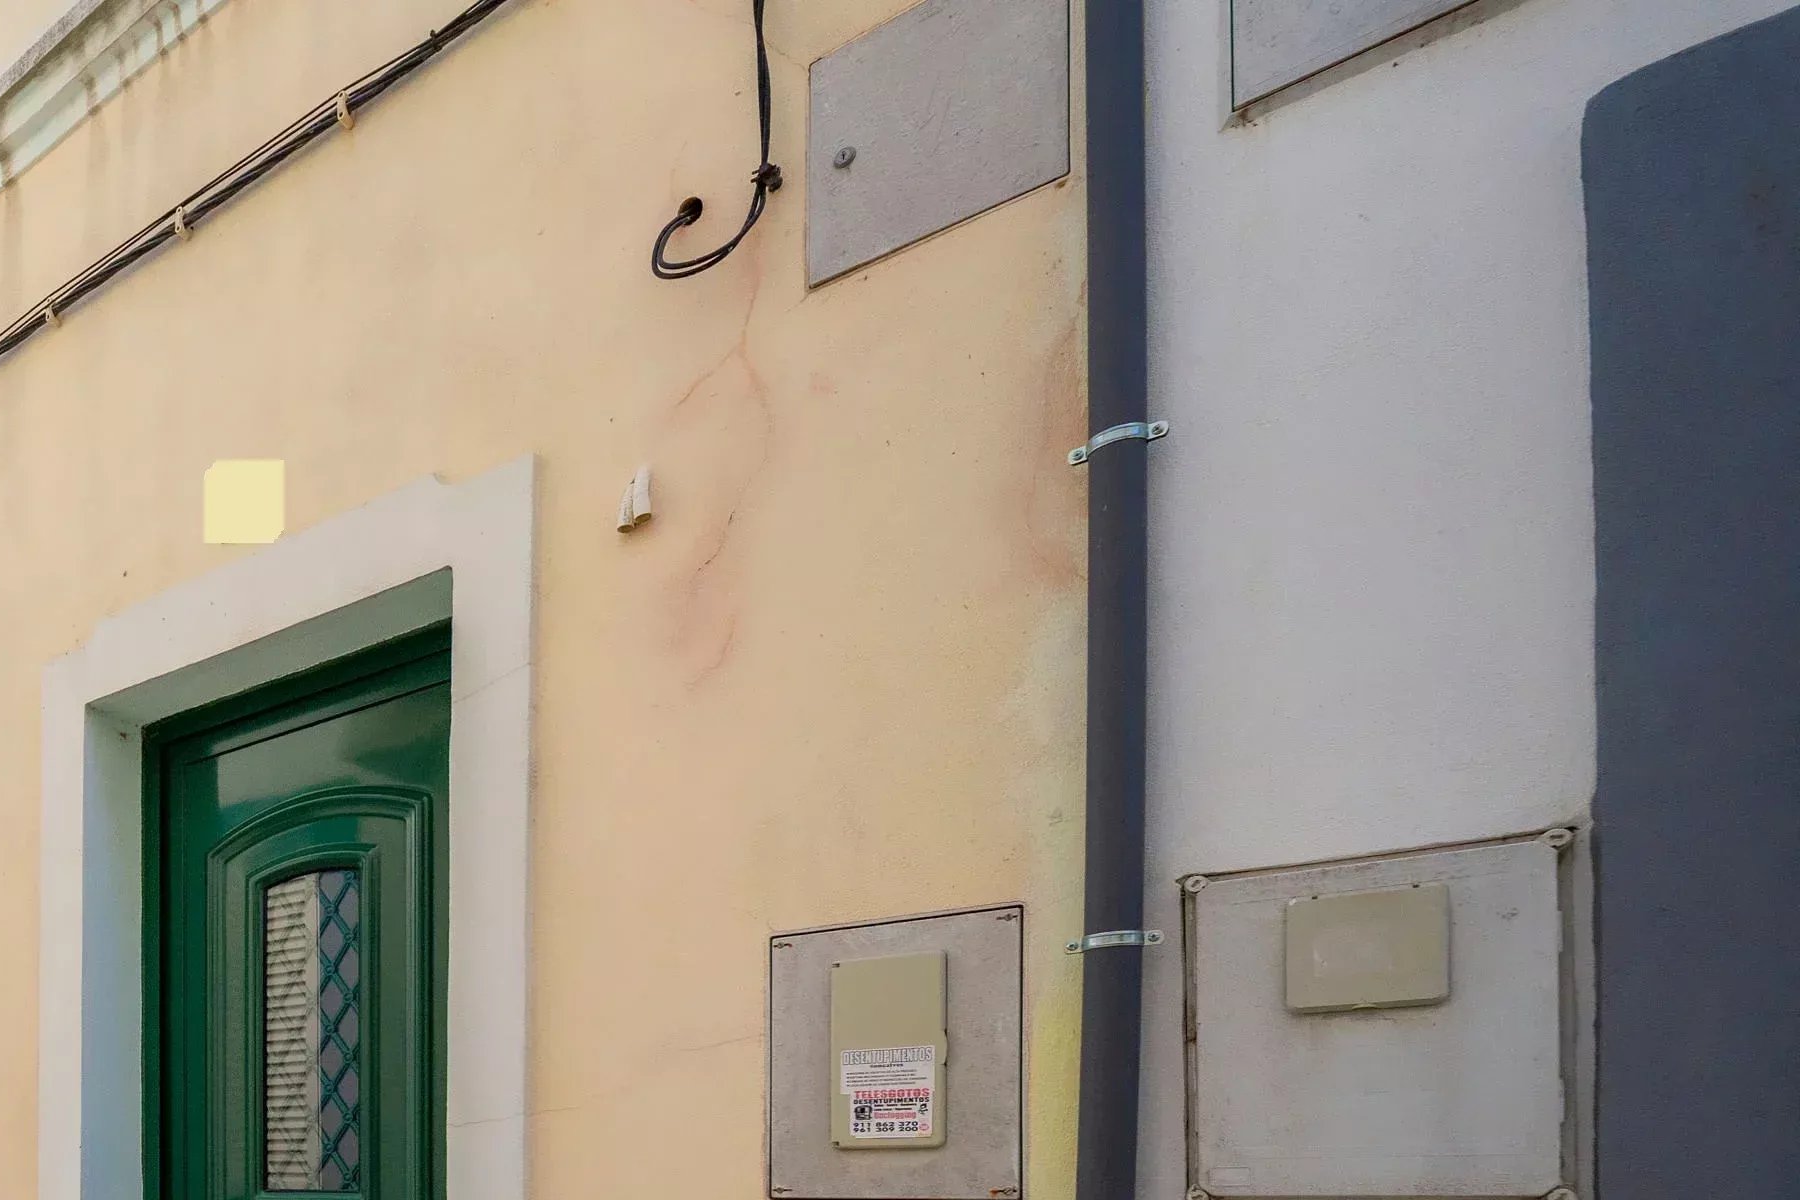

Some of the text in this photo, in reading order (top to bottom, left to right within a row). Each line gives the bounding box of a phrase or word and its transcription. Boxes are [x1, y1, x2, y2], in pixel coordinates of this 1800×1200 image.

[842, 1047, 932, 1065] DESENTUPIMENTOS
[854, 1088, 930, 1099] TELESGOTOS
[853, 1097, 930, 1105] DESENTUPIMENTOS
